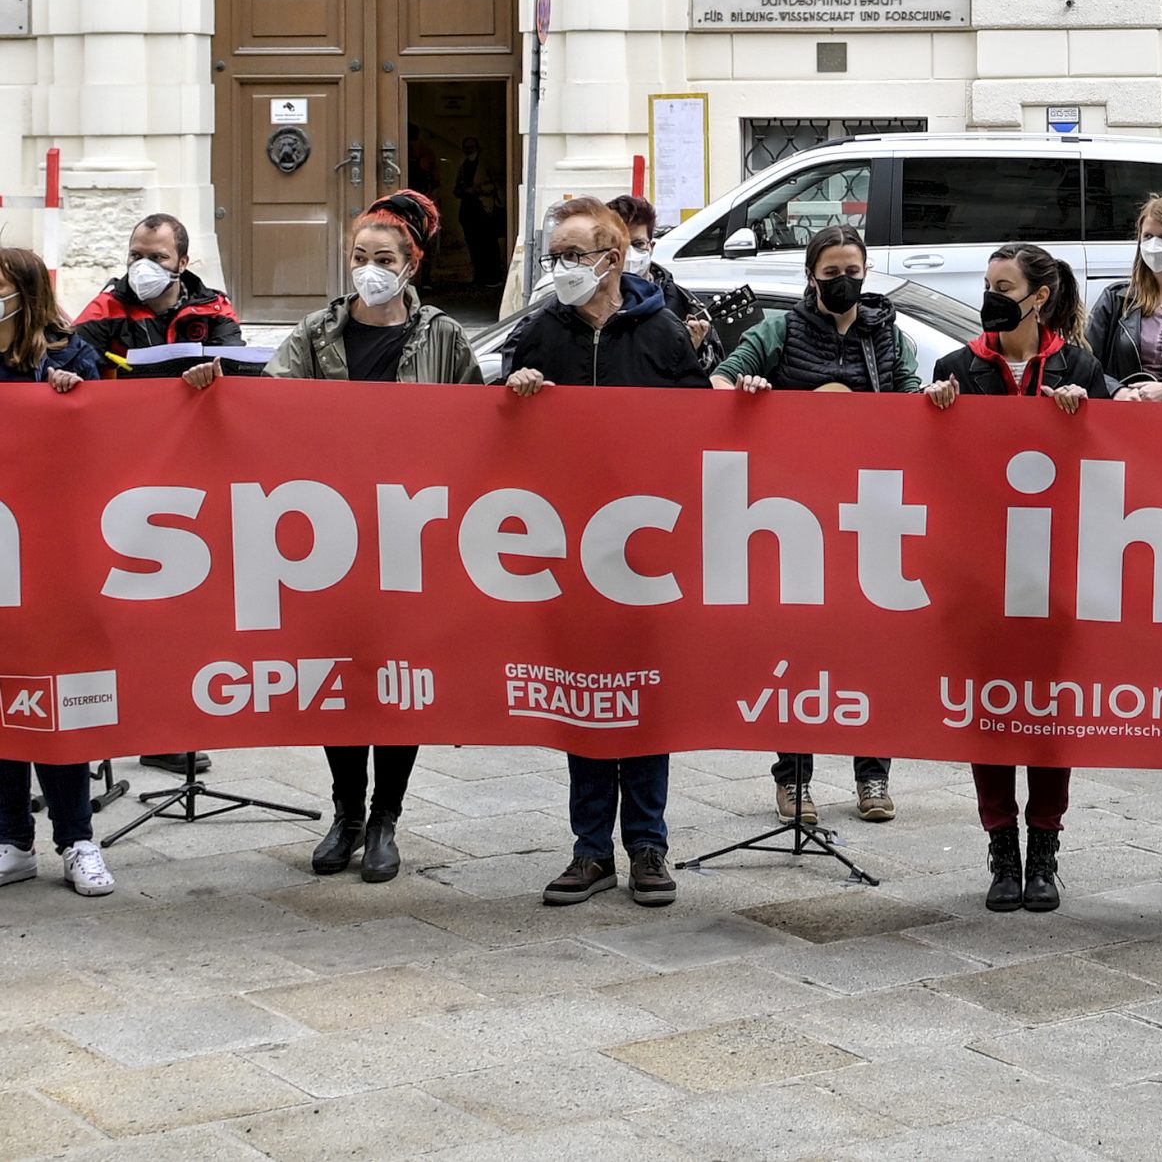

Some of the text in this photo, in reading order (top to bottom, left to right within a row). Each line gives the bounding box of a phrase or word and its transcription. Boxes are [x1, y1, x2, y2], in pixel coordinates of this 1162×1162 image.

[703, 9, 724, 23] FÜR
[860, 11, 881, 22] UND
[885, 10, 952, 22] FORSCHUNG
[101, 450, 931, 631] sprecht
[192, 657, 435, 716] GPA djp
[505, 663, 661, 689] GEWERKSCHAFTS
[6, 689, 113, 718] AK ÖSTERREICH
[506, 680, 639, 718] FRAUEN
[736, 659, 870, 727] vida
[979, 718, 1005, 731] Die
